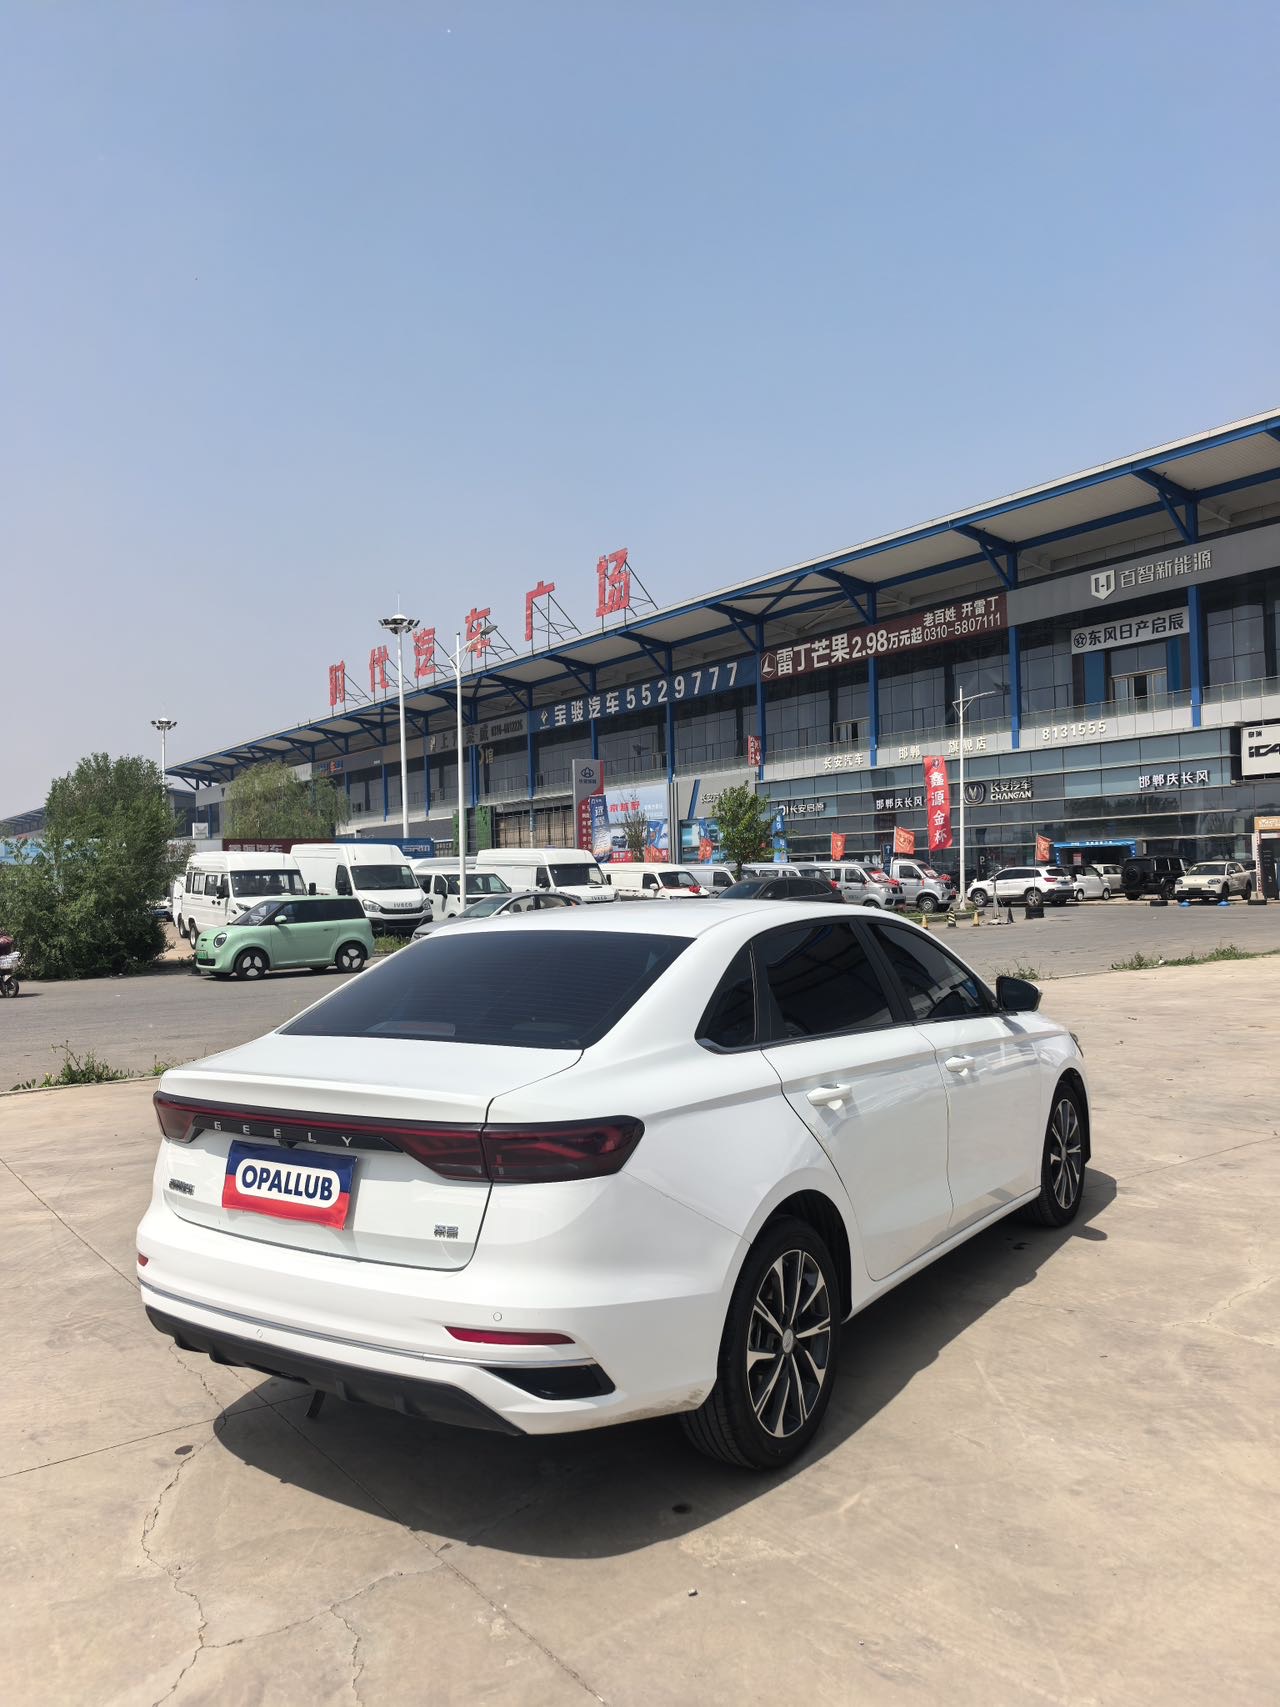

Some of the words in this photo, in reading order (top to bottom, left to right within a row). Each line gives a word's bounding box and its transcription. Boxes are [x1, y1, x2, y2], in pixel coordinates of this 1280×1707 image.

[1119, 550, 1212, 588] 百智新能源
[923, 608, 957, 627] 老百姓
[961, 595, 999, 618] 开雷丁
[923, 612, 1001, 642] 0310-5807111
[1088, 612, 1184, 646] 东风日产启辰
[823, 753, 864, 770] 长安汽车
[898, 745, 921, 760] 邯郸
[1042, 721, 1107, 740] 8131555
[990, 779, 1032, 793] 长安汽车
[1138, 769, 1209, 788] 邯郸庆长风
[929, 771, 947, 845] 鑫源金杯
[990, 790, 1032, 801] CHANGAN
[214, 1121, 353, 1147] GEELY
[241, 1165, 333, 1201] OPALLUB
